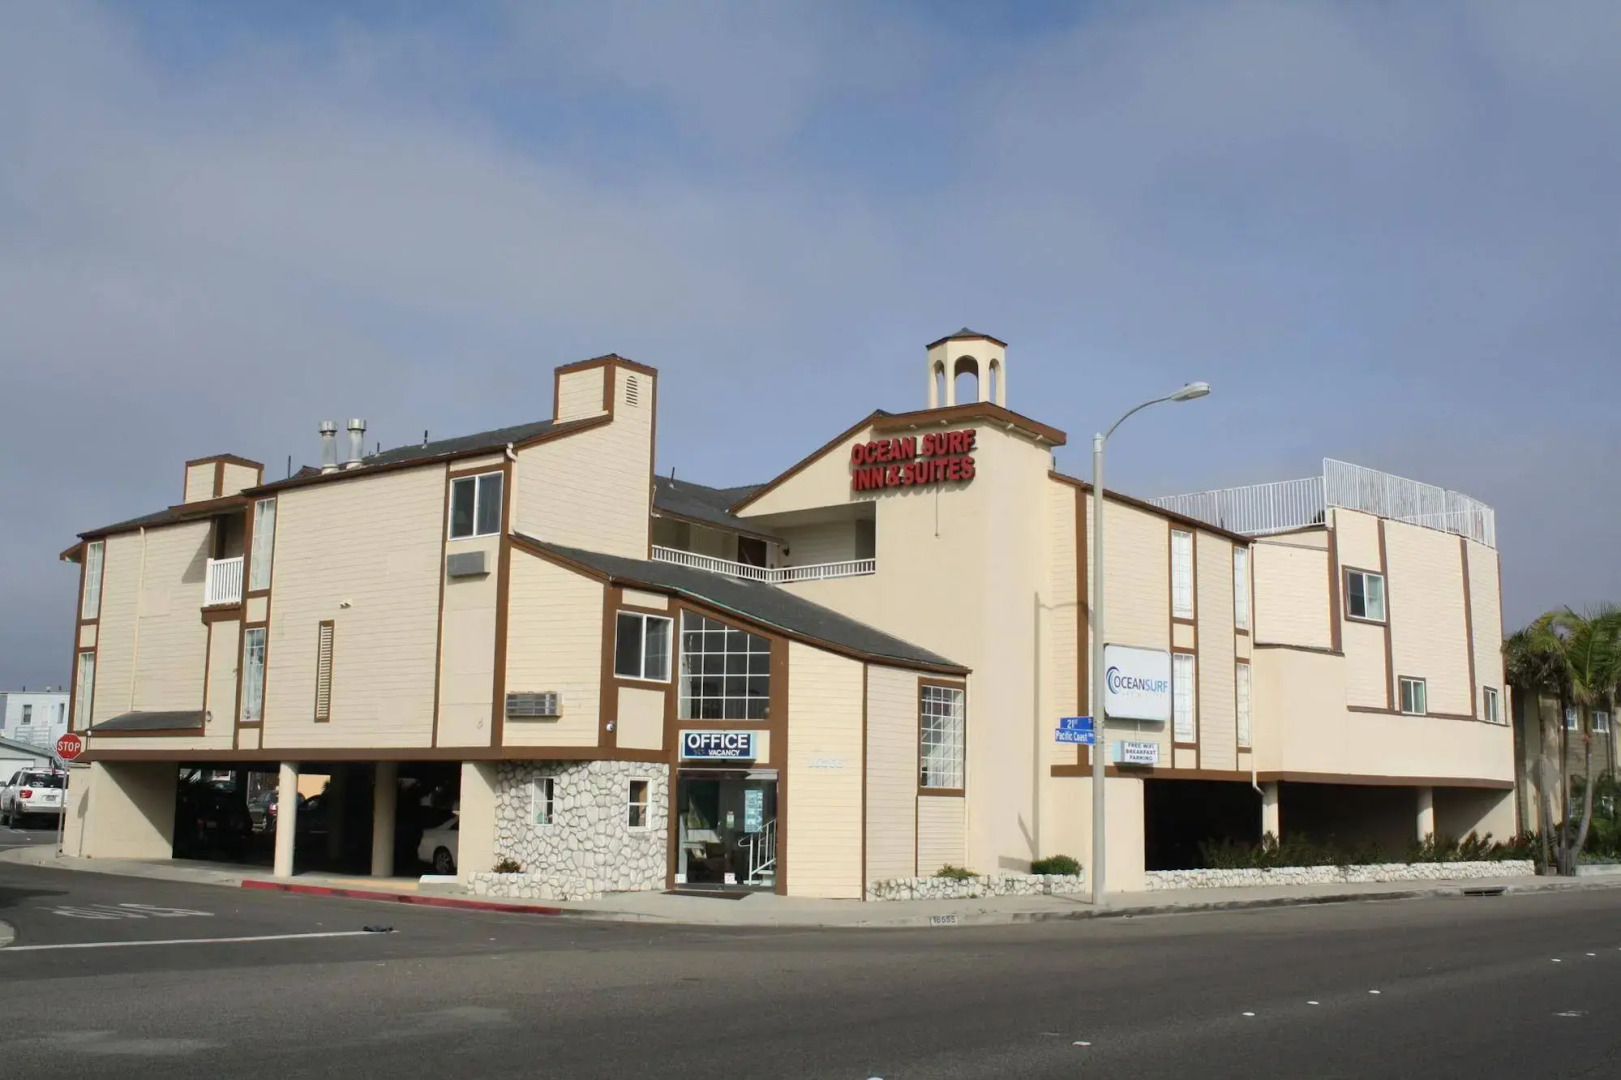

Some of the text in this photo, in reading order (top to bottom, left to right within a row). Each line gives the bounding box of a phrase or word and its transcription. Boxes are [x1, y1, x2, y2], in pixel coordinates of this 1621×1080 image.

[851, 429, 976, 466] OCEAN SURF
[852, 455, 976, 491] INN & SUITES
[687, 733, 748, 748] OFFICE
[1055, 730, 1073, 741] Pacific
[1073, 731, 1088, 742] Coast
[57, 741, 81, 752] STOP
